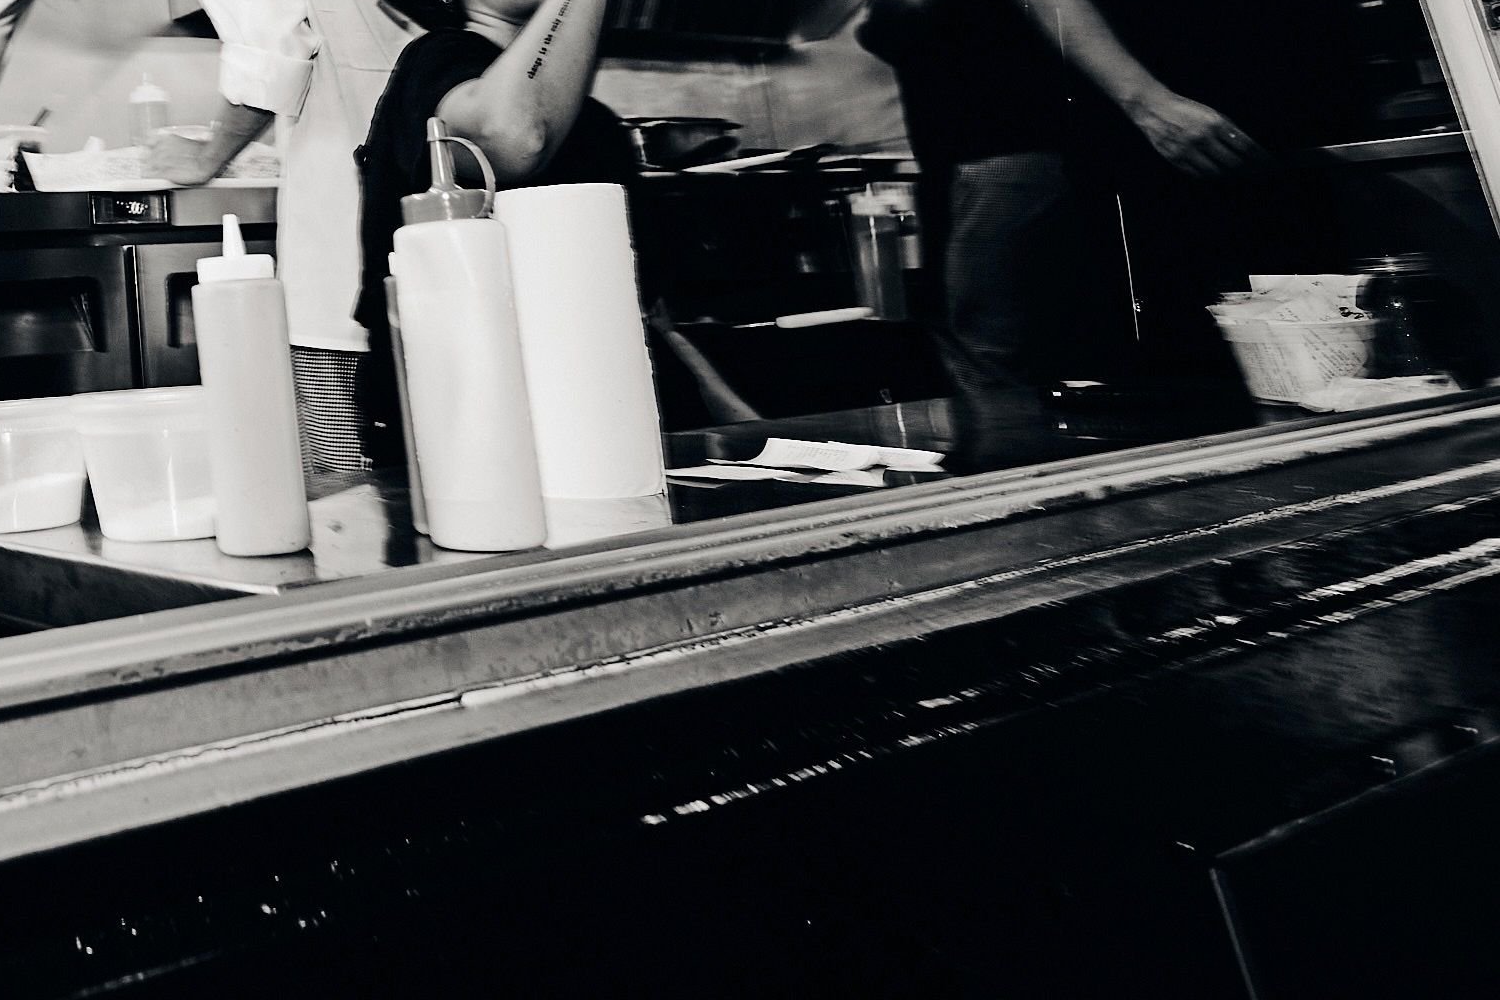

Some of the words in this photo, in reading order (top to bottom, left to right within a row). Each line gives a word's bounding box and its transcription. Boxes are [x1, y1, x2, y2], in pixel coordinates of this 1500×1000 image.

[527, 57, 542, 79] change
[538, 47, 547, 56] is
[544, 33, 553, 45] the
